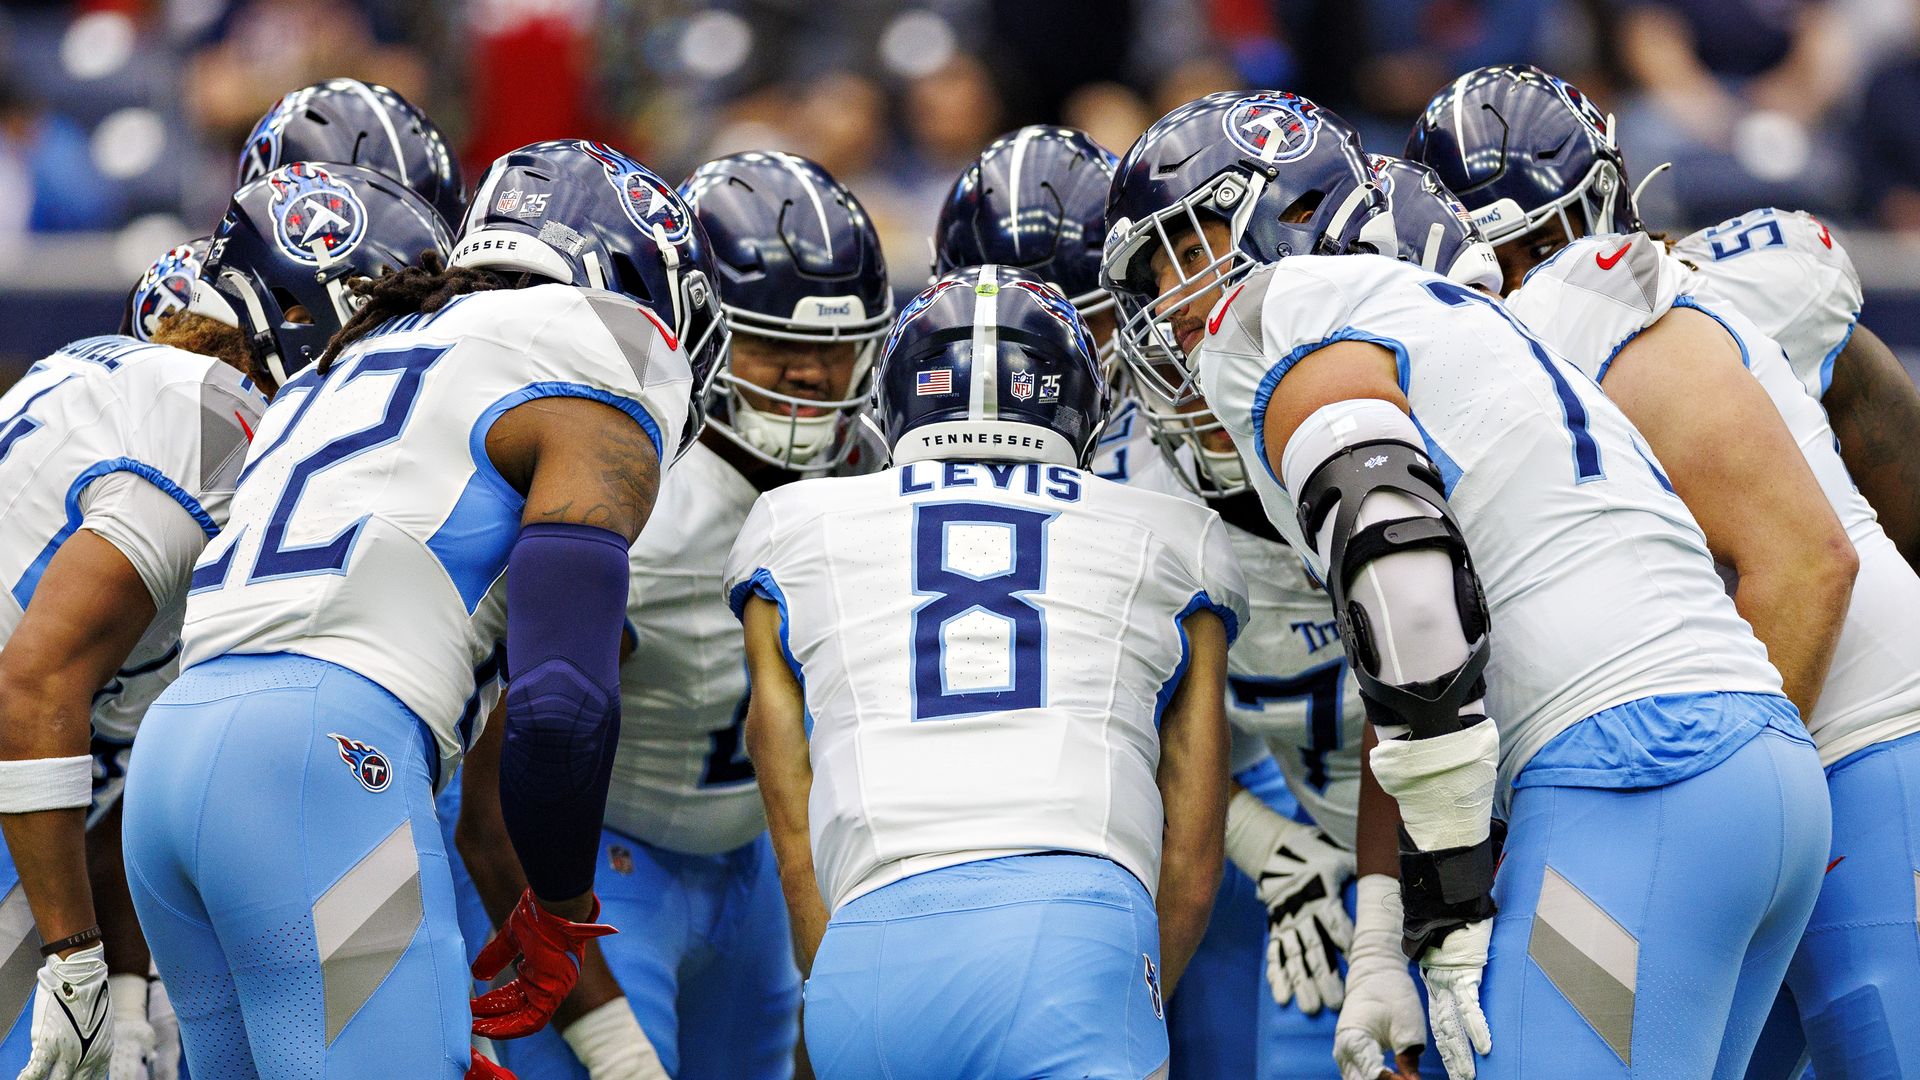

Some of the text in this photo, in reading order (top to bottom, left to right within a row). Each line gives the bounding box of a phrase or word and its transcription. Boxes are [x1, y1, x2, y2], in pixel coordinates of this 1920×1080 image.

[500, 199, 514, 210] NFL
[520, 193, 552, 213] 25
[1474, 206, 1502, 228] TANS
[452, 240, 518, 266] NESSEE
[1014, 383, 1031, 396] NFL
[1039, 374, 1062, 399] 25
[922, 433, 1045, 450] TENNESSEE
[187, 345, 458, 598] 22
[900, 461, 1083, 502] LEVIS
[910, 501, 1061, 722] 8
